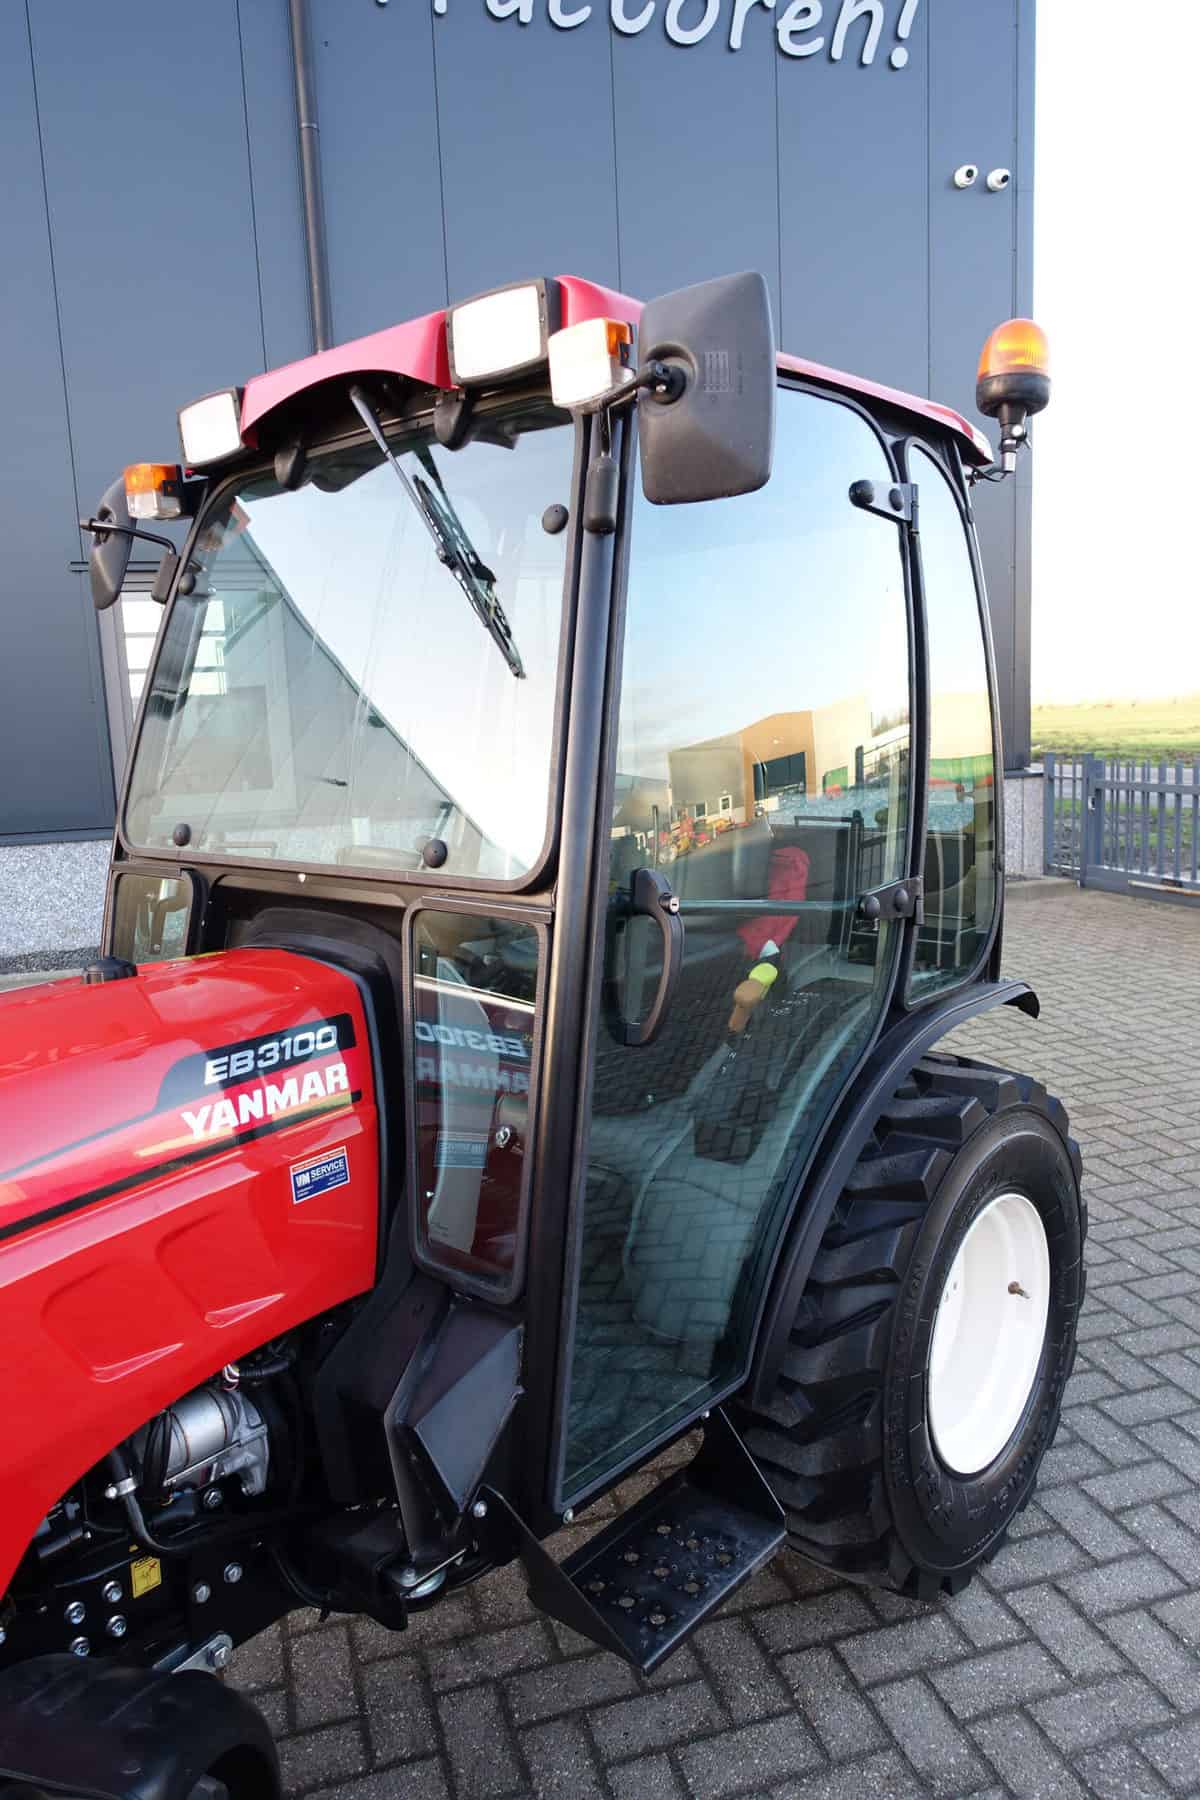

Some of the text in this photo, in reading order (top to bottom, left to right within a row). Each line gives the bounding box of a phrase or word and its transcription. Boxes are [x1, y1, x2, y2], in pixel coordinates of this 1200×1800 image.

[376, 0, 919, 68] coren!
[204, 1025, 338, 1086] EB3100
[180, 1062, 350, 1140] YANMAR
[310, 1158, 345, 1179] SERVICE
